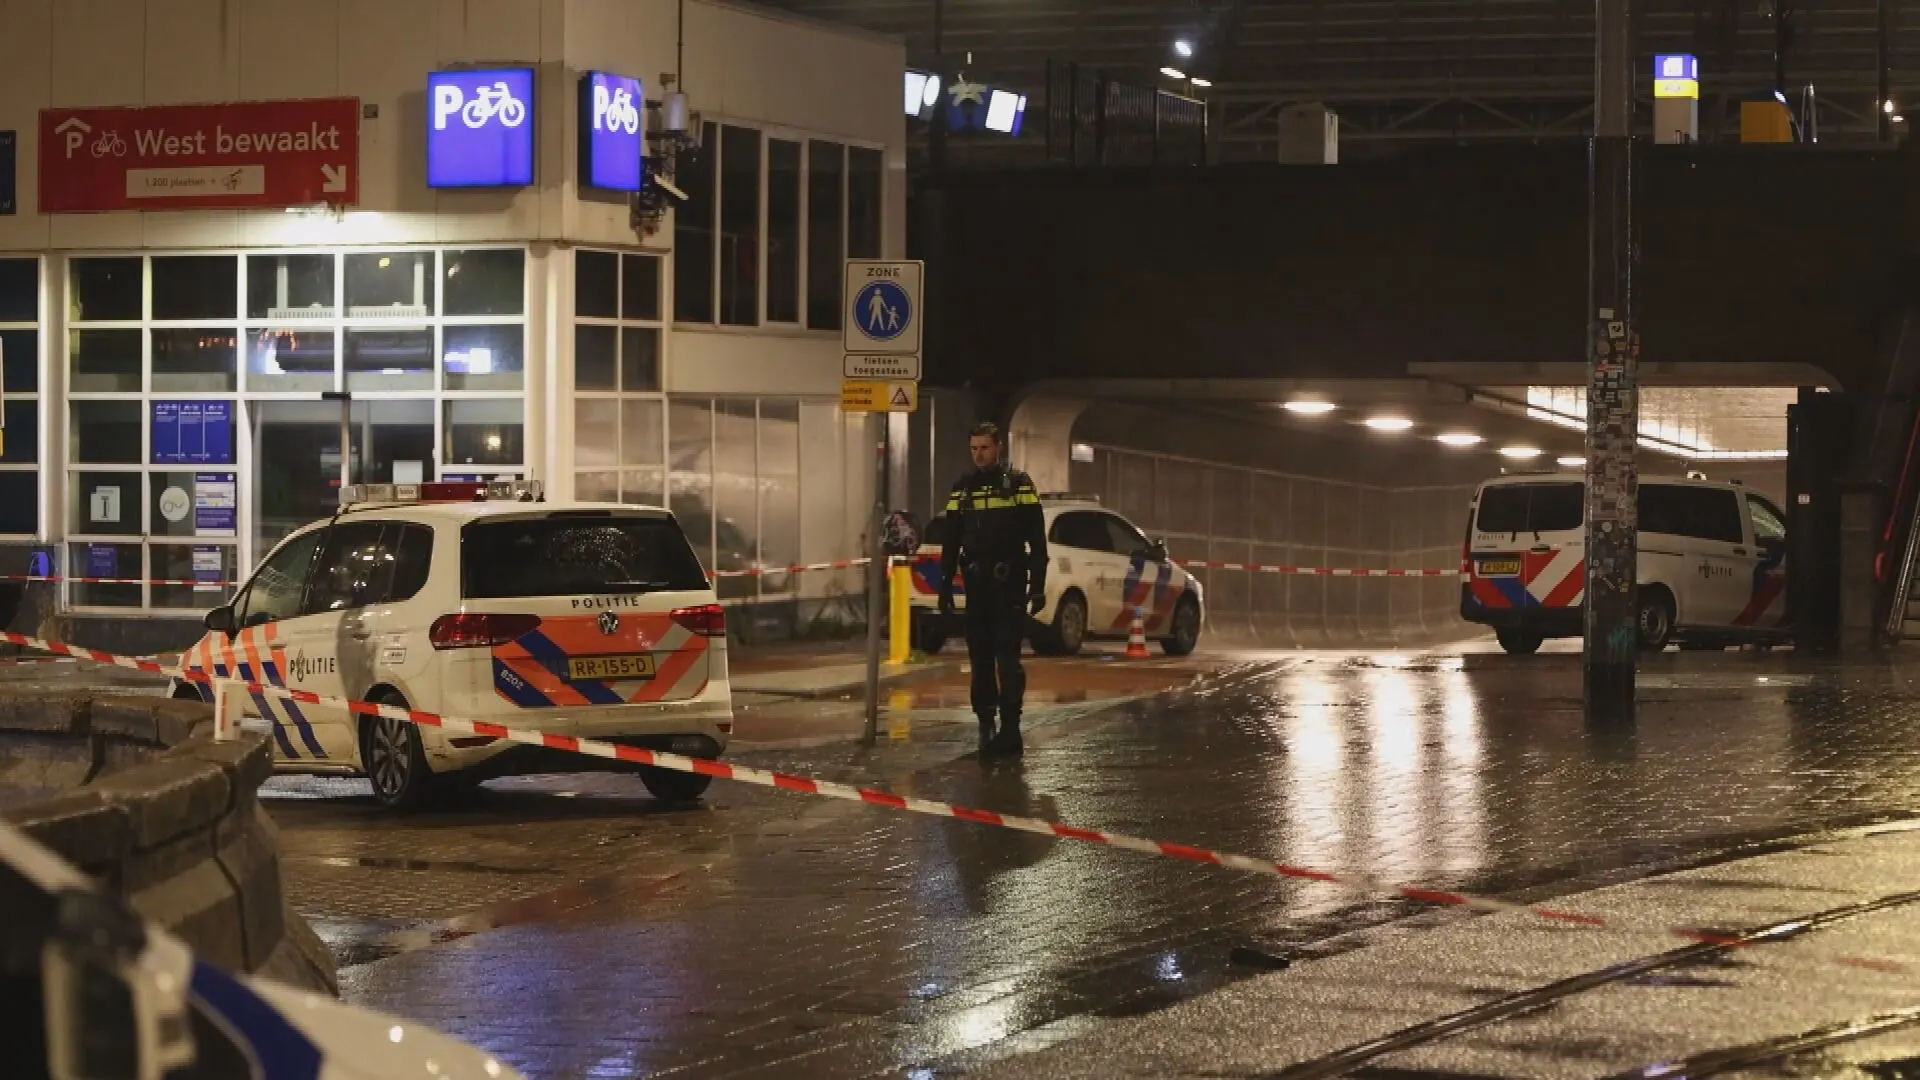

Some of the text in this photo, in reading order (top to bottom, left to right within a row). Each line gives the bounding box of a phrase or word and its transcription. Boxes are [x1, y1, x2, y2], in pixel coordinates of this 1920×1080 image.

[434, 85, 464, 131] P
[594, 85, 609, 129] P
[65, 120, 341, 158] P West bewaakt
[867, 267, 901, 278] ZONE
[571, 594, 640, 609] POLITIE
